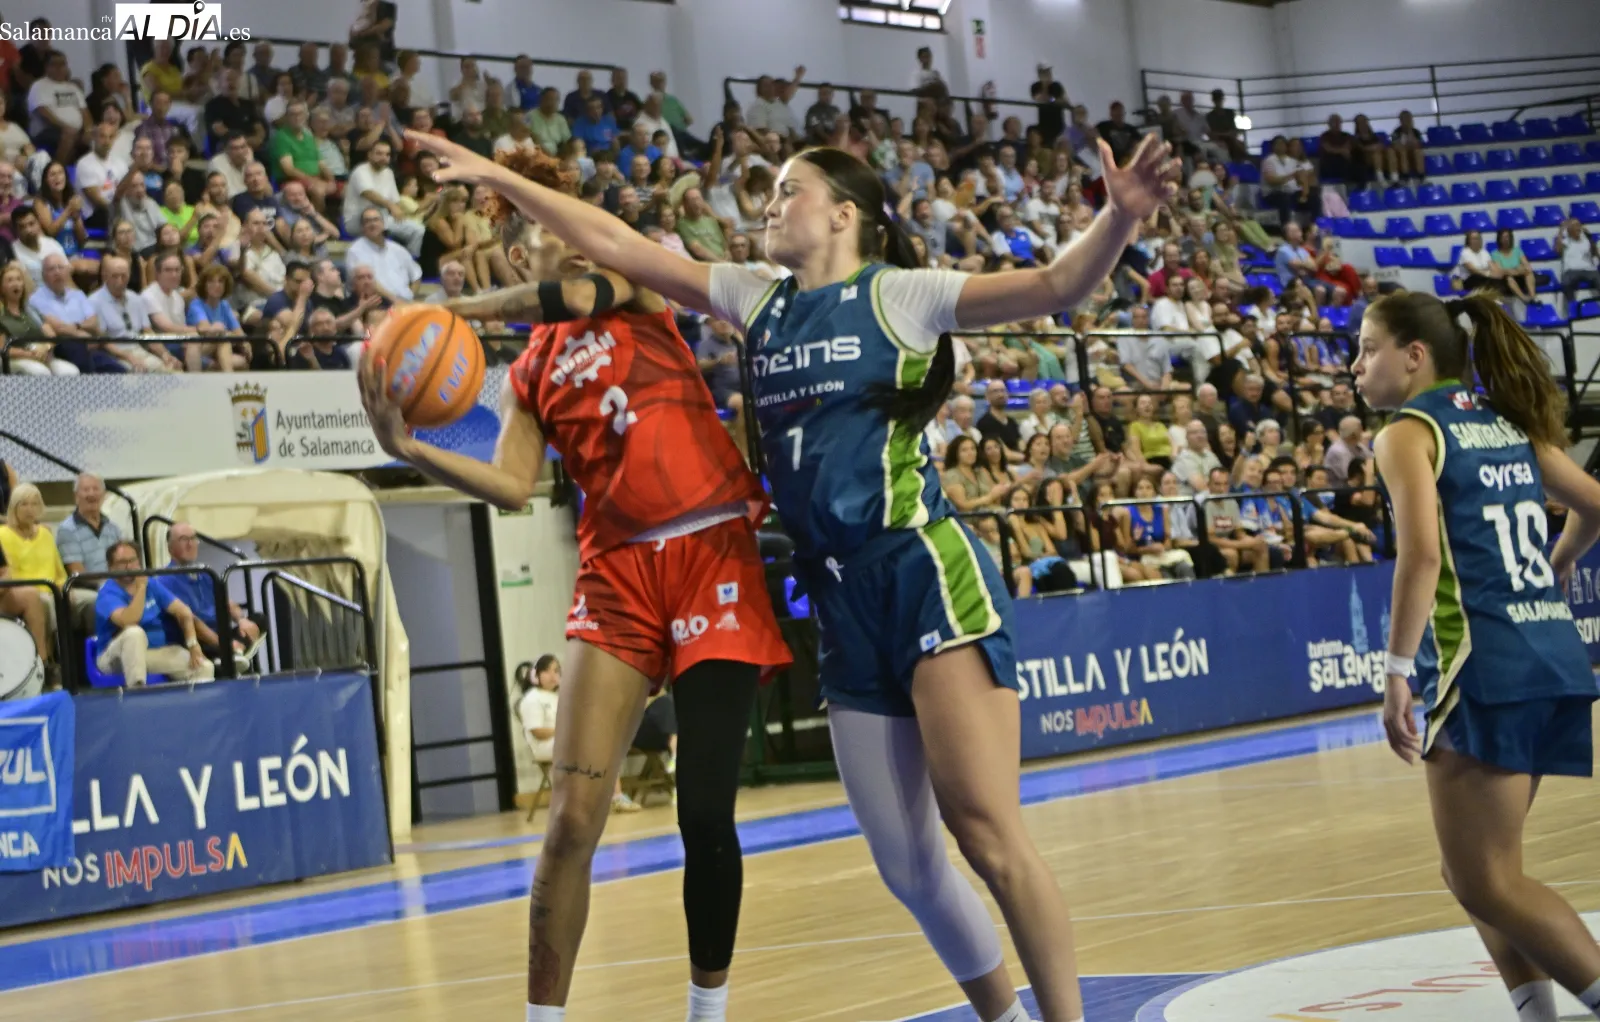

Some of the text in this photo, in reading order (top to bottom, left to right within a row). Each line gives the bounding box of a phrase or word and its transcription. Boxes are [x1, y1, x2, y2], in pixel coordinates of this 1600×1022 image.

[800, 387, 807, 397] Y
[276, 409, 371, 435] Ayuntamiento
[279, 436, 375, 458] de Salamanca
[1113, 648, 1132, 696] Y
[1140, 627, 1209, 683] LEÓN
[1041, 698, 1153, 739] NOS IMPULSA
[180, 764, 213, 830] Y
[233, 734, 350, 812] LEÓN
[42, 832, 249, 892] NOS IMPULSA
